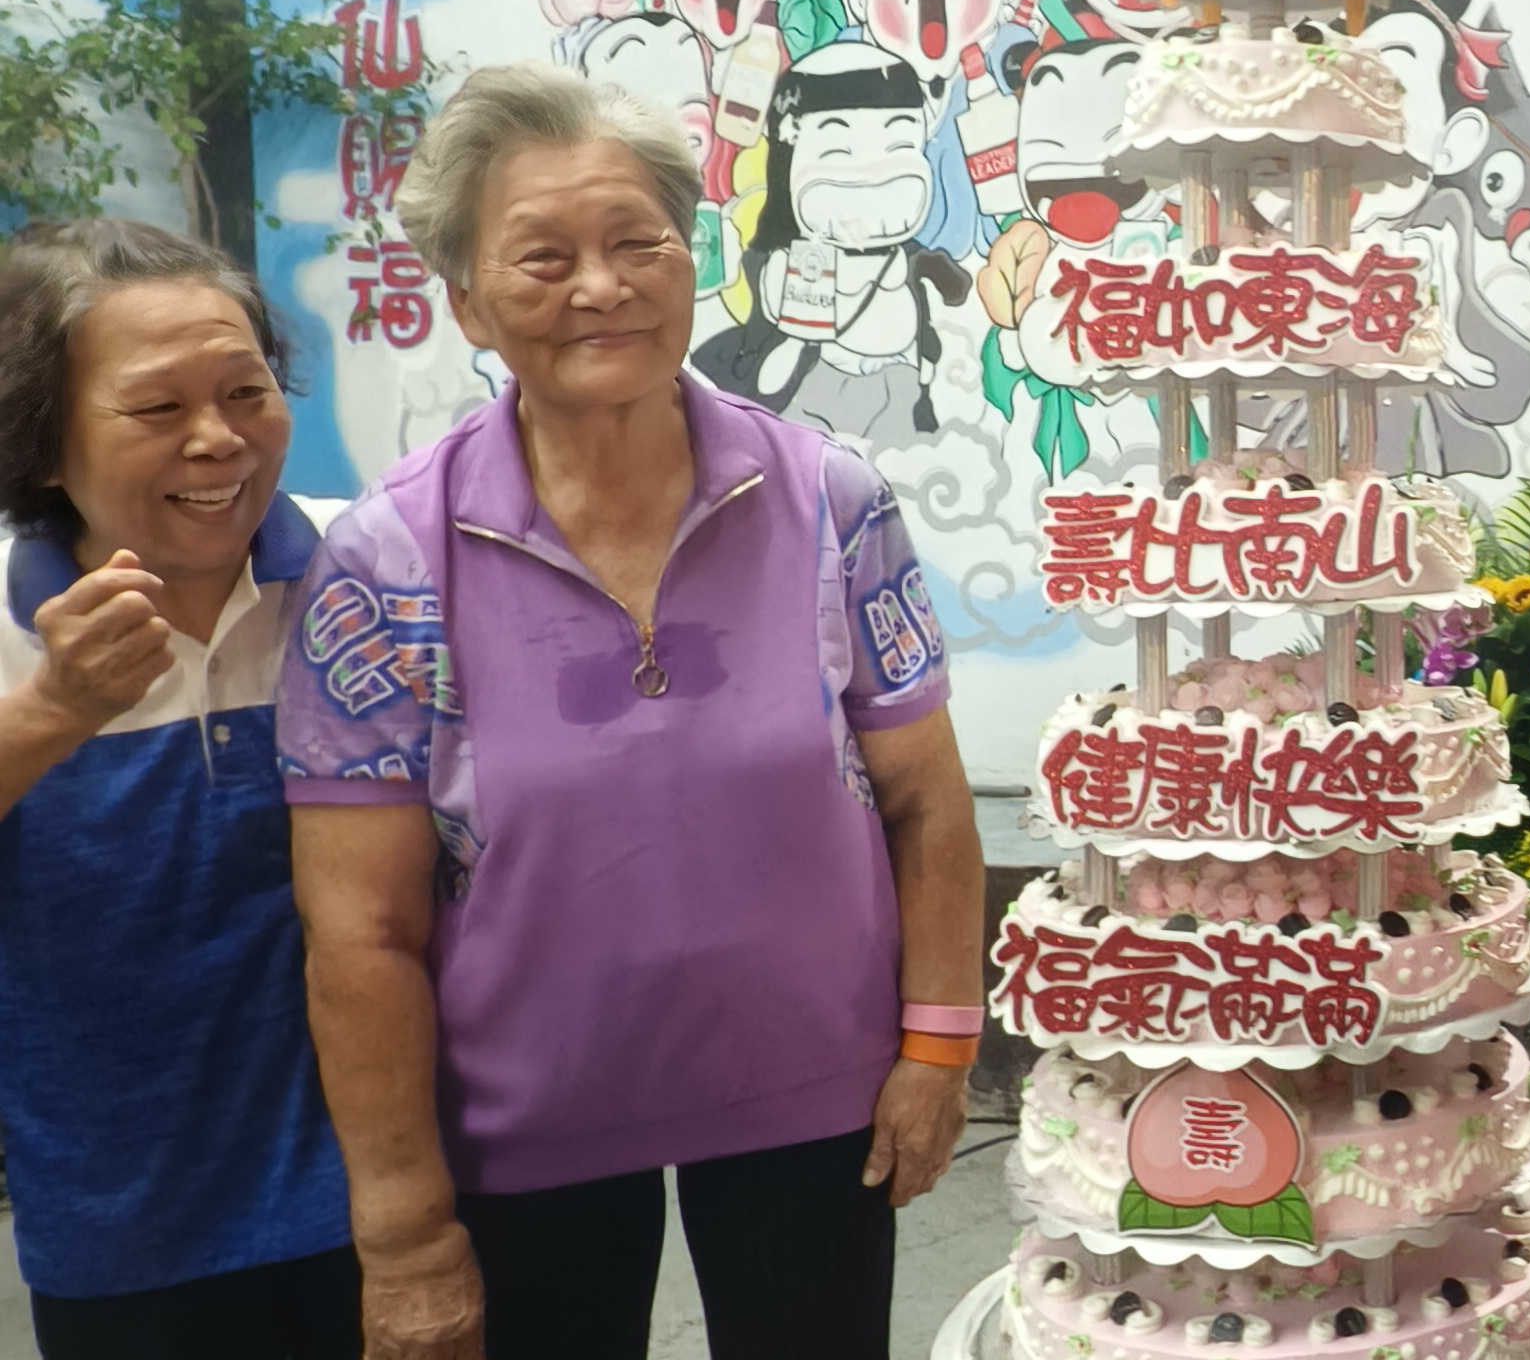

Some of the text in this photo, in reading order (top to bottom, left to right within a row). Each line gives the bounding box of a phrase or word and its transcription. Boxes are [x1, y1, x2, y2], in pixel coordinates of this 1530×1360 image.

[1050, 245, 1422, 362] 福如東海
[1041, 484, 1413, 603] 壽比南山
[1042, 723, 1424, 840] 健康快樂
[993, 921, 1384, 1047] 福氣滿滿
